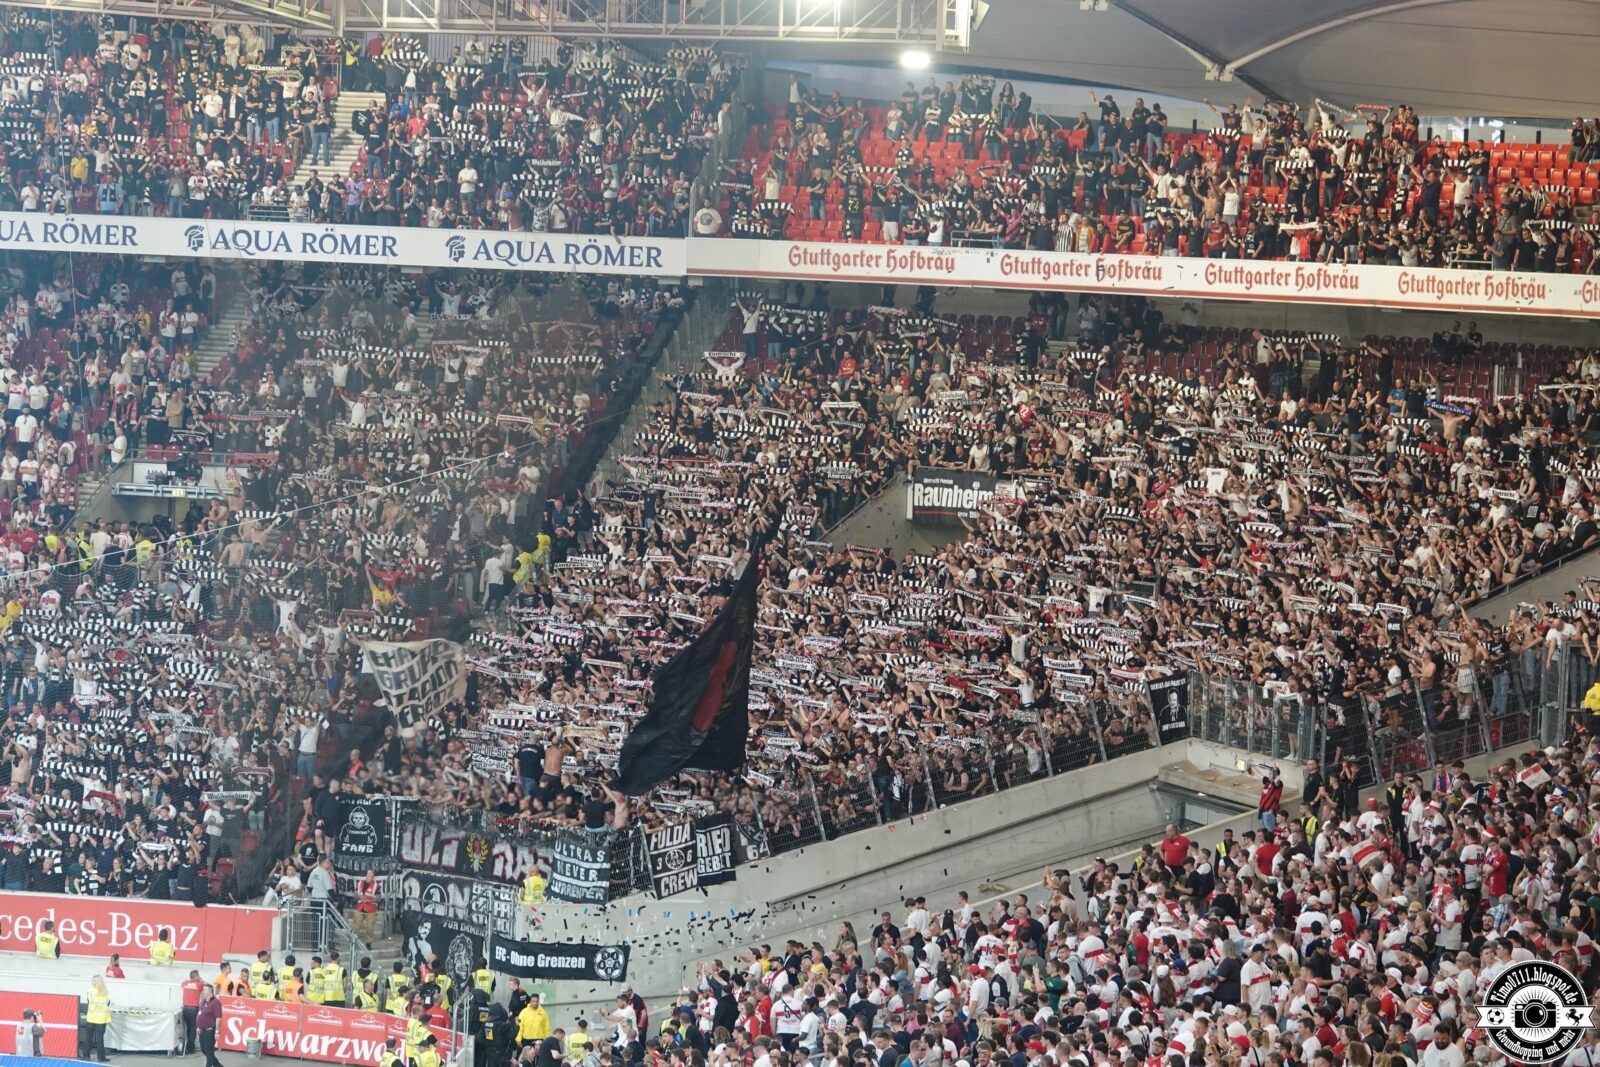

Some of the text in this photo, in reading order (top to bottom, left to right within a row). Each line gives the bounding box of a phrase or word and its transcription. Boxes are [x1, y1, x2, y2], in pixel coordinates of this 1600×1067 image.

[42, 217, 138, 246] RÖMER
[211, 227, 398, 259] AQUA RÖMER
[472, 238, 663, 269] AQUA RÖMER
[788, 245, 882, 272] Stuttgarter
[1000, 252, 1163, 283] Stuttgarter Hofbräu
[1204, 262, 1359, 291] Stuttgarter Hofbräu
[1398, 271, 1547, 300] Stuttgarter Hofbräu
[913, 481, 994, 510] Raunheim
[554, 839, 606, 862] ULTRAS
[651, 823, 691, 850] FULDA
[696, 827, 732, 858] RIED
[556, 860, 599, 882] NEVER
[656, 849, 693, 871] 3 6
[660, 866, 698, 897] CREW
[495, 946, 507, 962] EFC
[510, 950, 535, 968] Ohne
[537, 953, 586, 969] Grenzen
